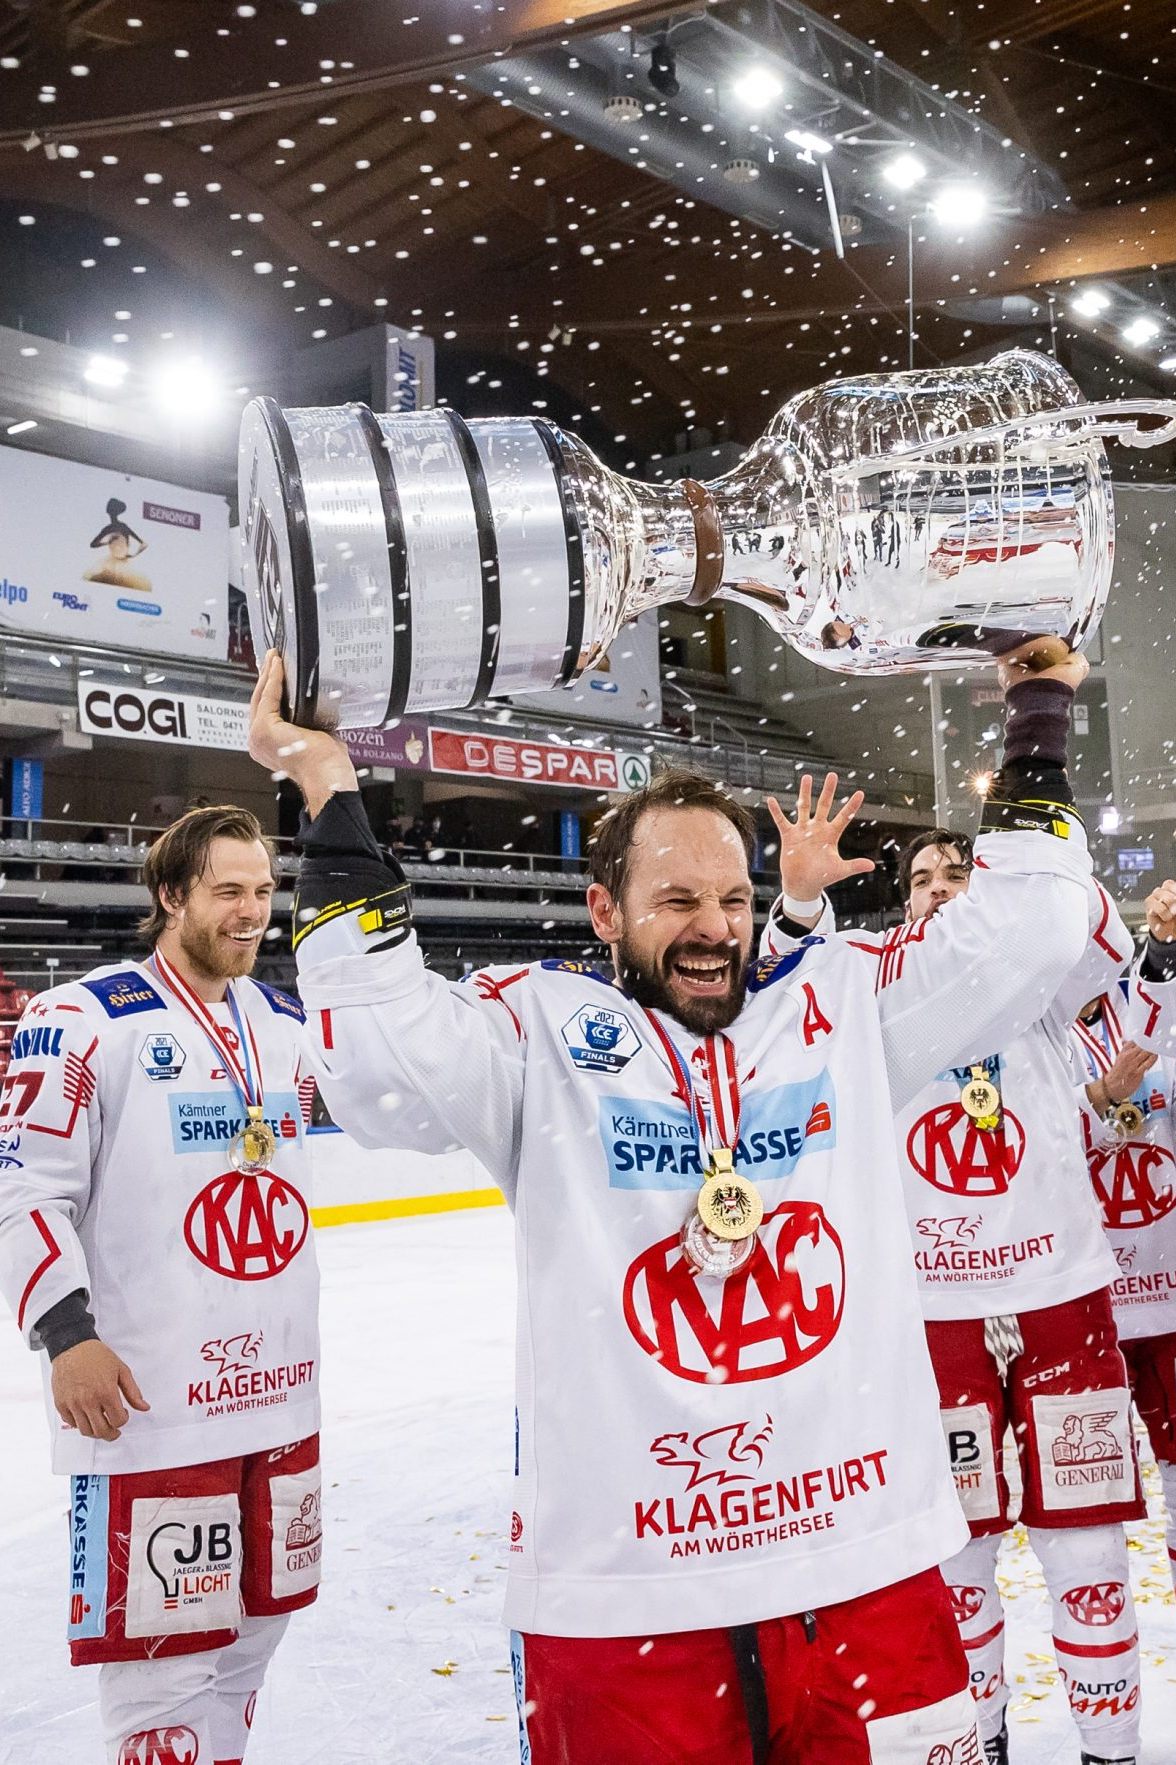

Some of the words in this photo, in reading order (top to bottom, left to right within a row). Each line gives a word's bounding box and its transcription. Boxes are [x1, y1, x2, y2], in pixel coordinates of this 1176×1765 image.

[464, 741, 616, 783] DESPAR
[594, 1011, 615, 1025] 2021
[802, 982, 833, 1046] A
[153, 1066, 176, 1075] FINALS
[580, 1051, 615, 1063] FINALS
[613, 1126, 803, 1174] SPARASSE
[184, 1168, 309, 1281] KAC
[925, 1273, 941, 1283] AM
[943, 1267, 1015, 1282] WÖRTHERSEE
[623, 1200, 846, 1385] KAC
[188, 1360, 314, 1406] KLAGENFURT
[1023, 1361, 1070, 1389] CCM
[207, 1404, 224, 1417] AM
[226, 1392, 288, 1413] WÖRTHERSEE
[948, 1430, 980, 1463] B
[1055, 1462, 1124, 1487] GENERALI
[634, 1448, 888, 1538] KLAGENFURT
[174, 1522, 232, 1564] JB
[670, 1534, 701, 1558] AM
[705, 1512, 836, 1554] WÖRTHERSEE
[183, 1573, 231, 1595] LICHT
[1077, 1679, 1127, 1696] AUTO
